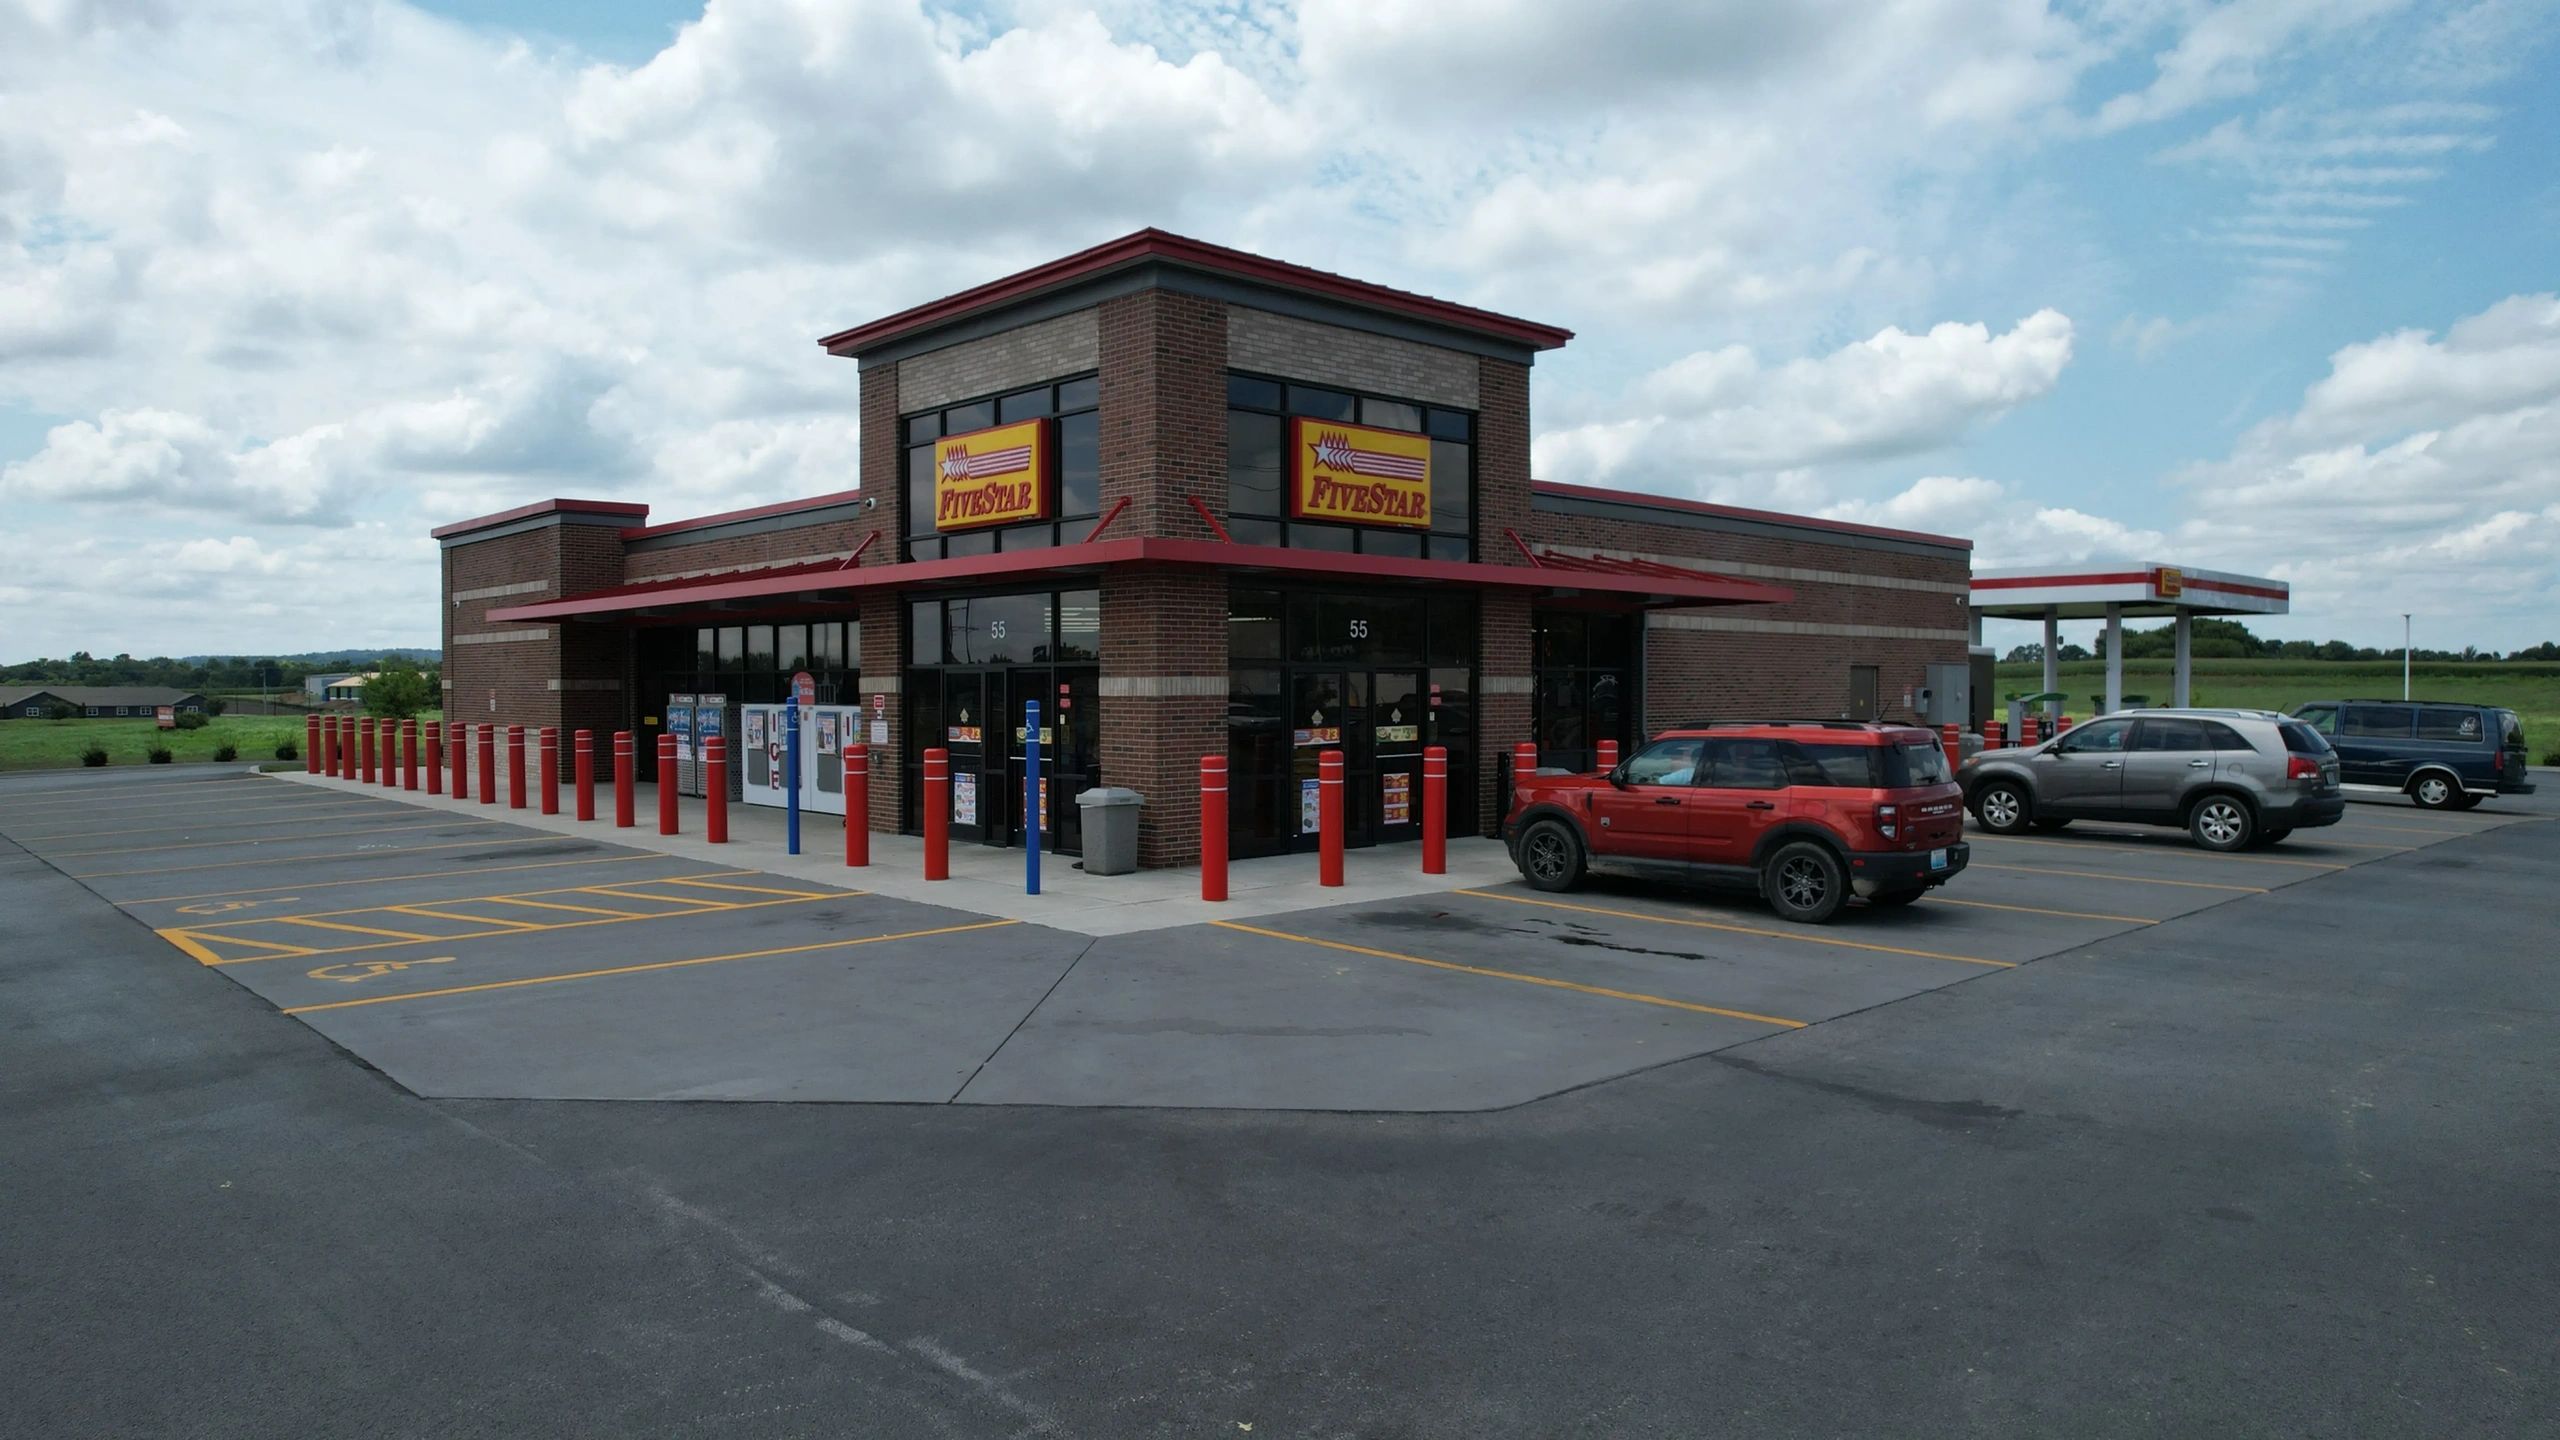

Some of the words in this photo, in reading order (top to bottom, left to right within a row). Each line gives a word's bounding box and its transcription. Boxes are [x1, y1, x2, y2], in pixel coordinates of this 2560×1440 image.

[991, 620, 1006, 639] 55
[1350, 620, 1368, 638] 55
[769, 713, 780, 790] ICE
